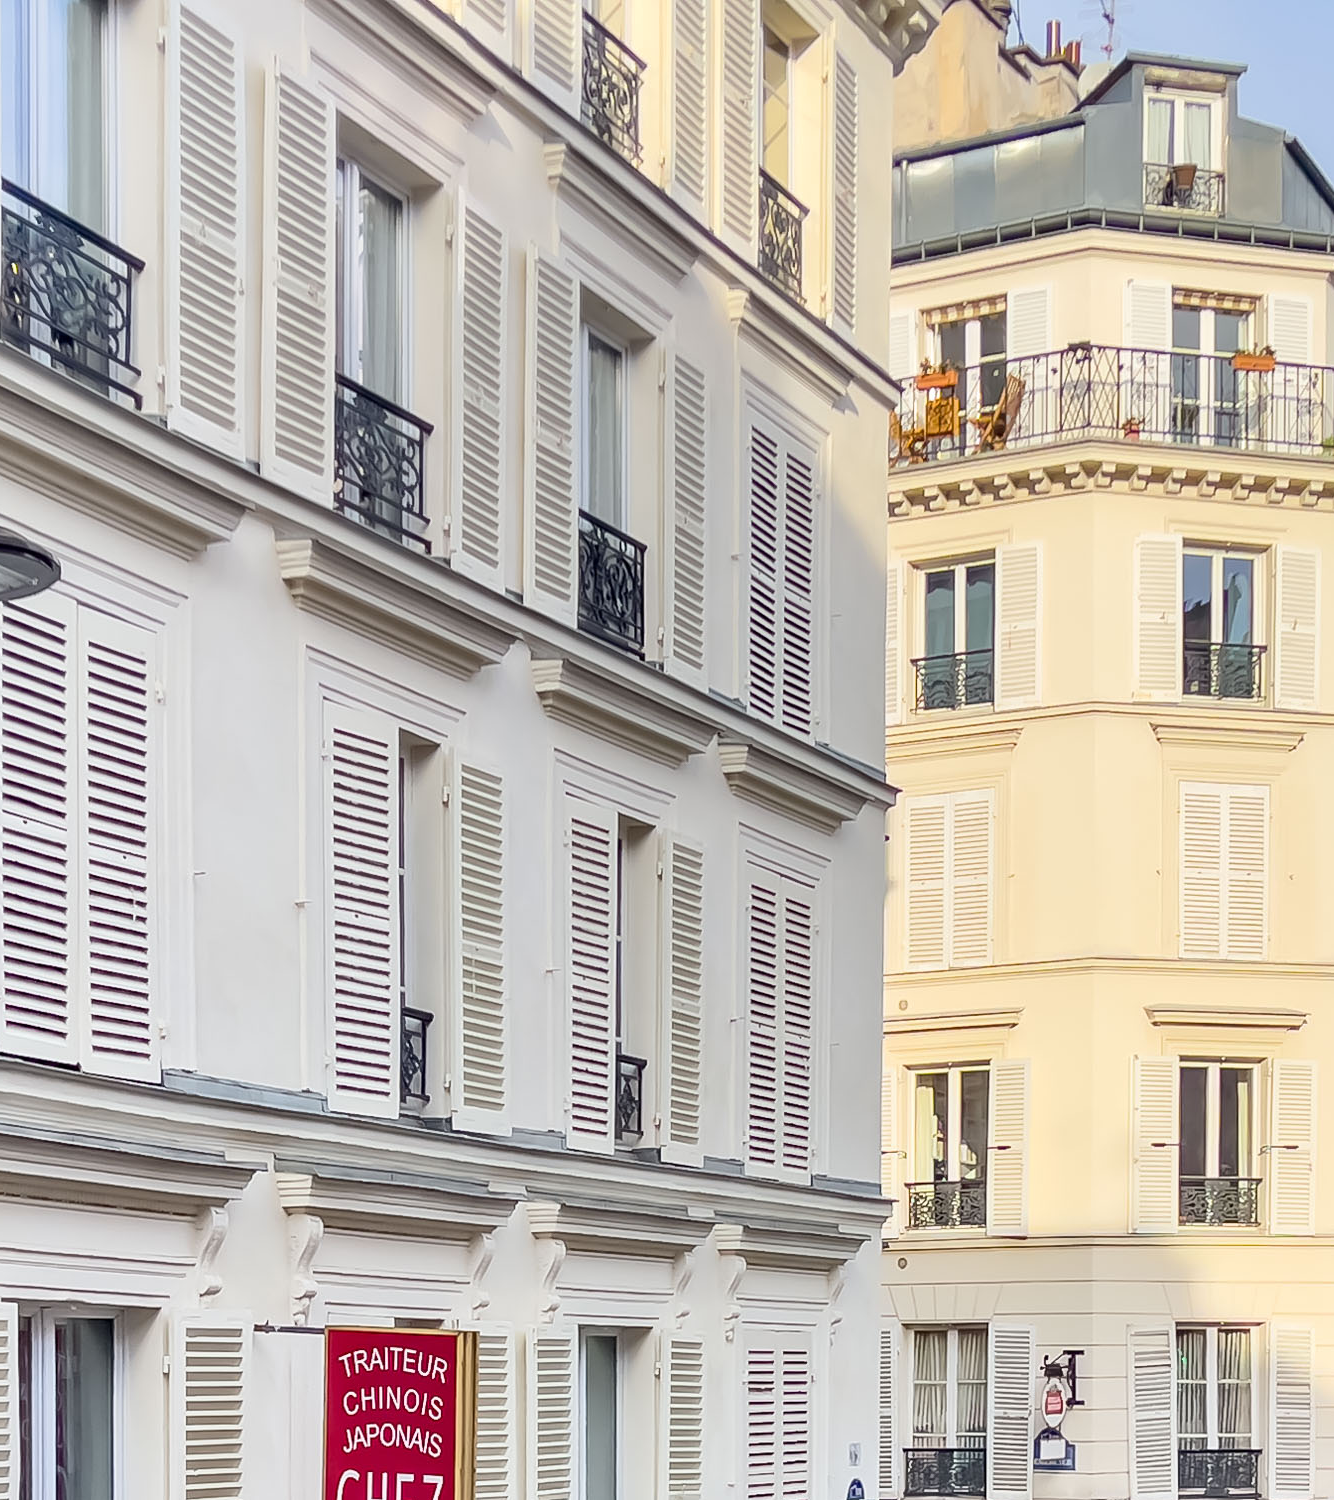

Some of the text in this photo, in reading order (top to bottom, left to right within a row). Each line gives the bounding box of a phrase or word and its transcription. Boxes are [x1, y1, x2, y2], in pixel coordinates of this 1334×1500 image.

[338, 1346, 448, 1384] TRAITEUR
[343, 1386, 444, 1420] CHINOIS
[342, 1423, 443, 1458] JAPONAIS
